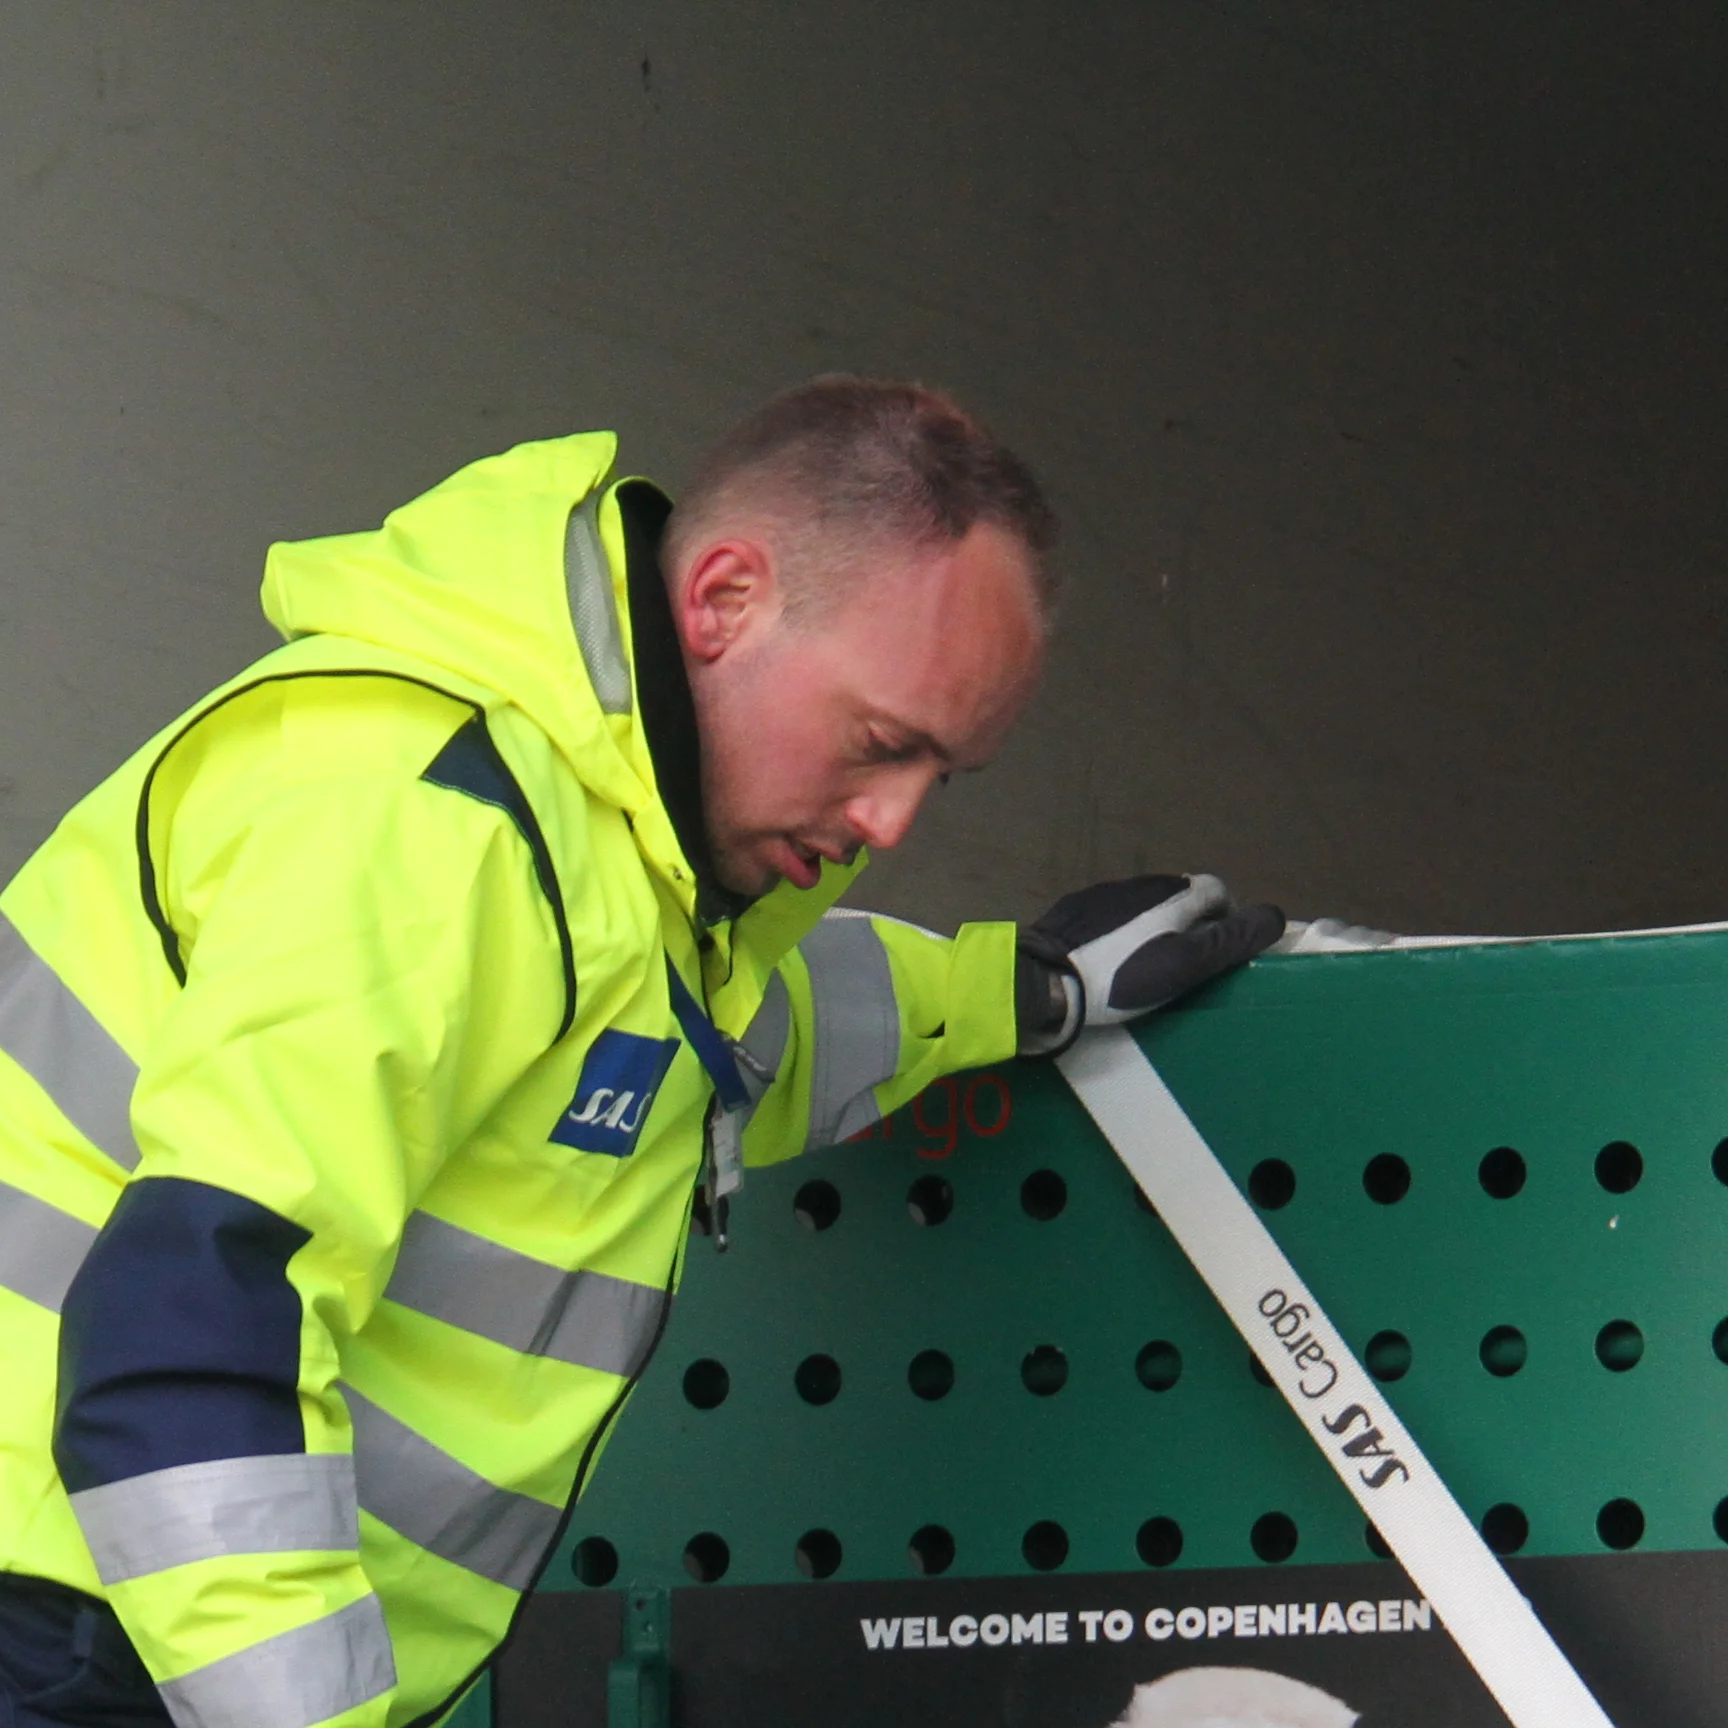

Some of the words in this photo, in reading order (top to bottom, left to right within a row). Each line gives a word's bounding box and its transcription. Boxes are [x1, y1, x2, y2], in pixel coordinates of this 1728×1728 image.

[1258, 1288, 1338, 1399] Cargo
[1322, 1403, 1410, 1488] SAS
[860, 1611, 1069, 1650] WELCOME
[1078, 1610, 1138, 1643] TO
[1143, 1600, 1432, 1639] COPENHAGEN
